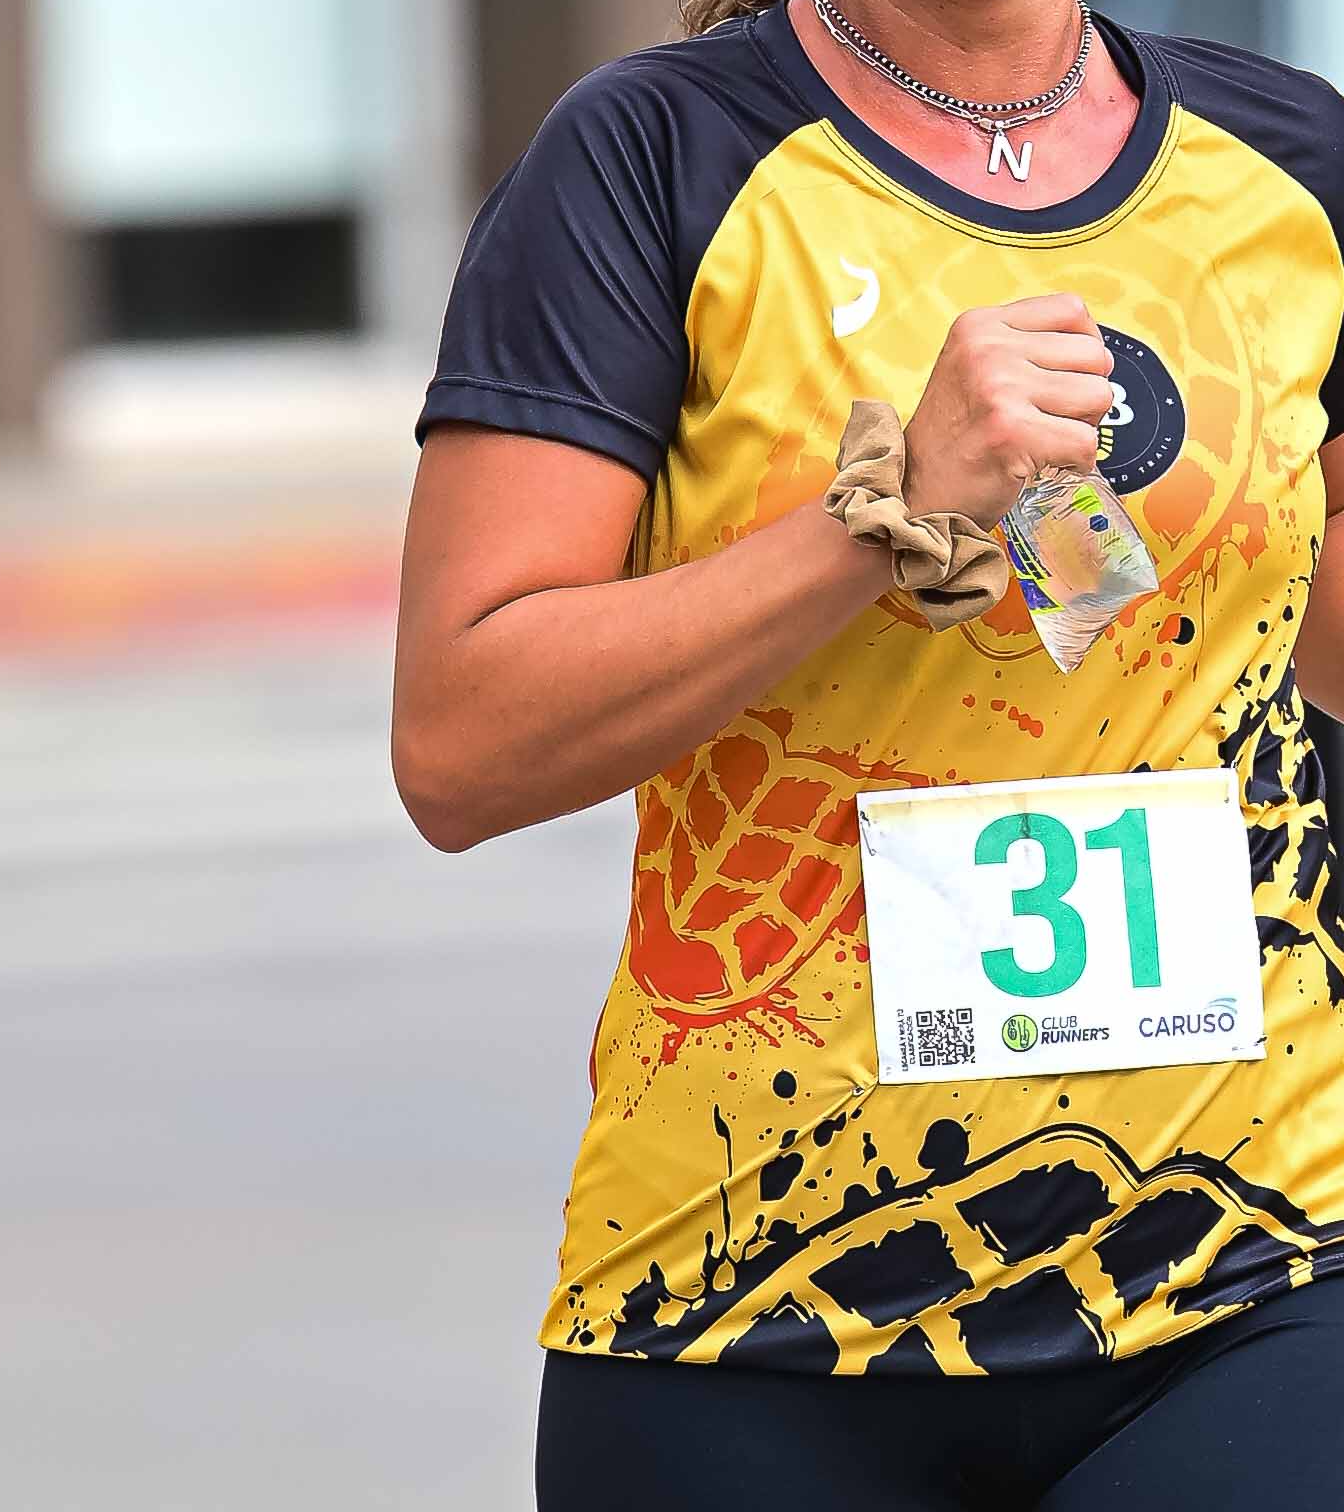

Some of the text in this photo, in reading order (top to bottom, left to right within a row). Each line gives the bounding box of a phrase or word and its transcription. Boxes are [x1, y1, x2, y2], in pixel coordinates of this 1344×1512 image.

[988, 128, 1033, 182] N
[1104, 335, 1144, 358] CLUB
[1106, 436, 1172, 484] ND TRAIL
[974, 808, 1161, 997] 31
[1041, 1015, 1077, 1030] CLUB
[1138, 1012, 1235, 1038] CARUSO
[1040, 1027, 1110, 1045] RUNNER'S
